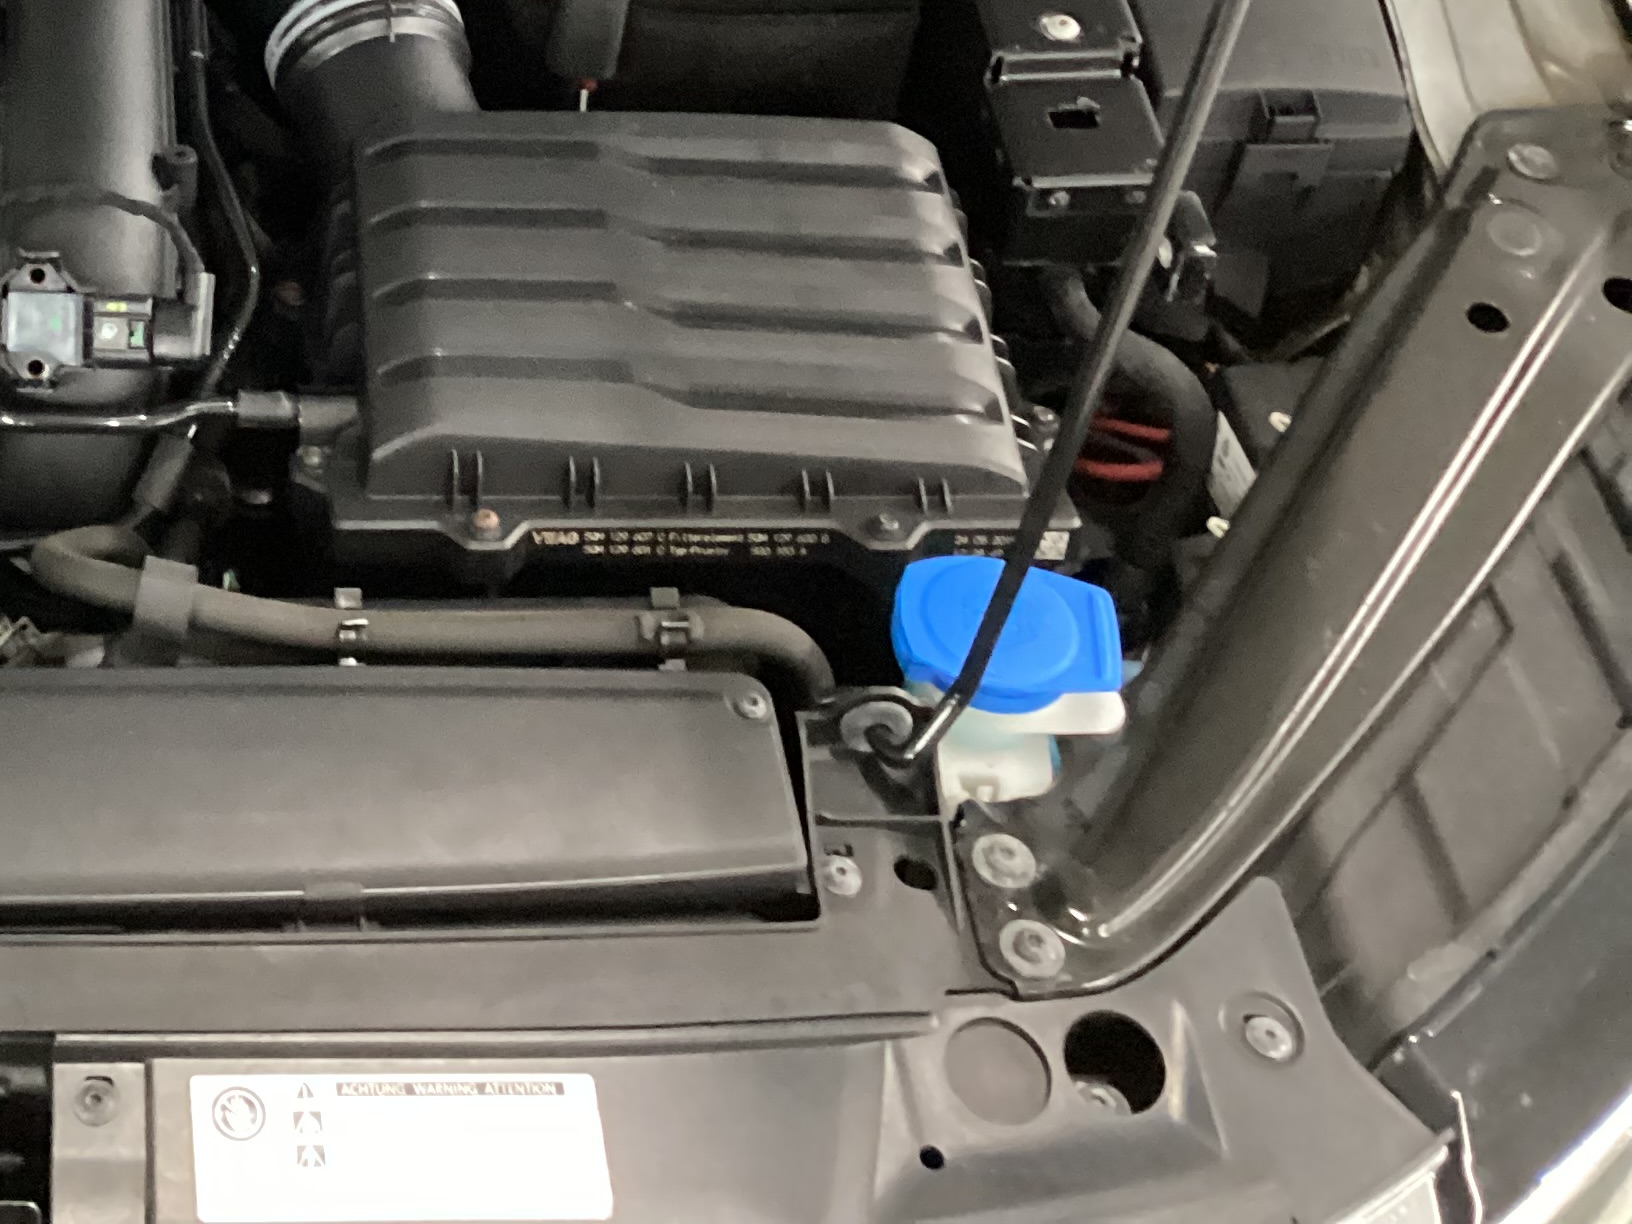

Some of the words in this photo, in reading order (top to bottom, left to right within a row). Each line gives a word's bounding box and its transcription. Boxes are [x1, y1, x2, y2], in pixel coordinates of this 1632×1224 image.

[340, 1082, 406, 1096] ACHTUNG
[413, 1082, 479, 1096] WARNING
[484, 1082, 558, 1096] ATTENTION
